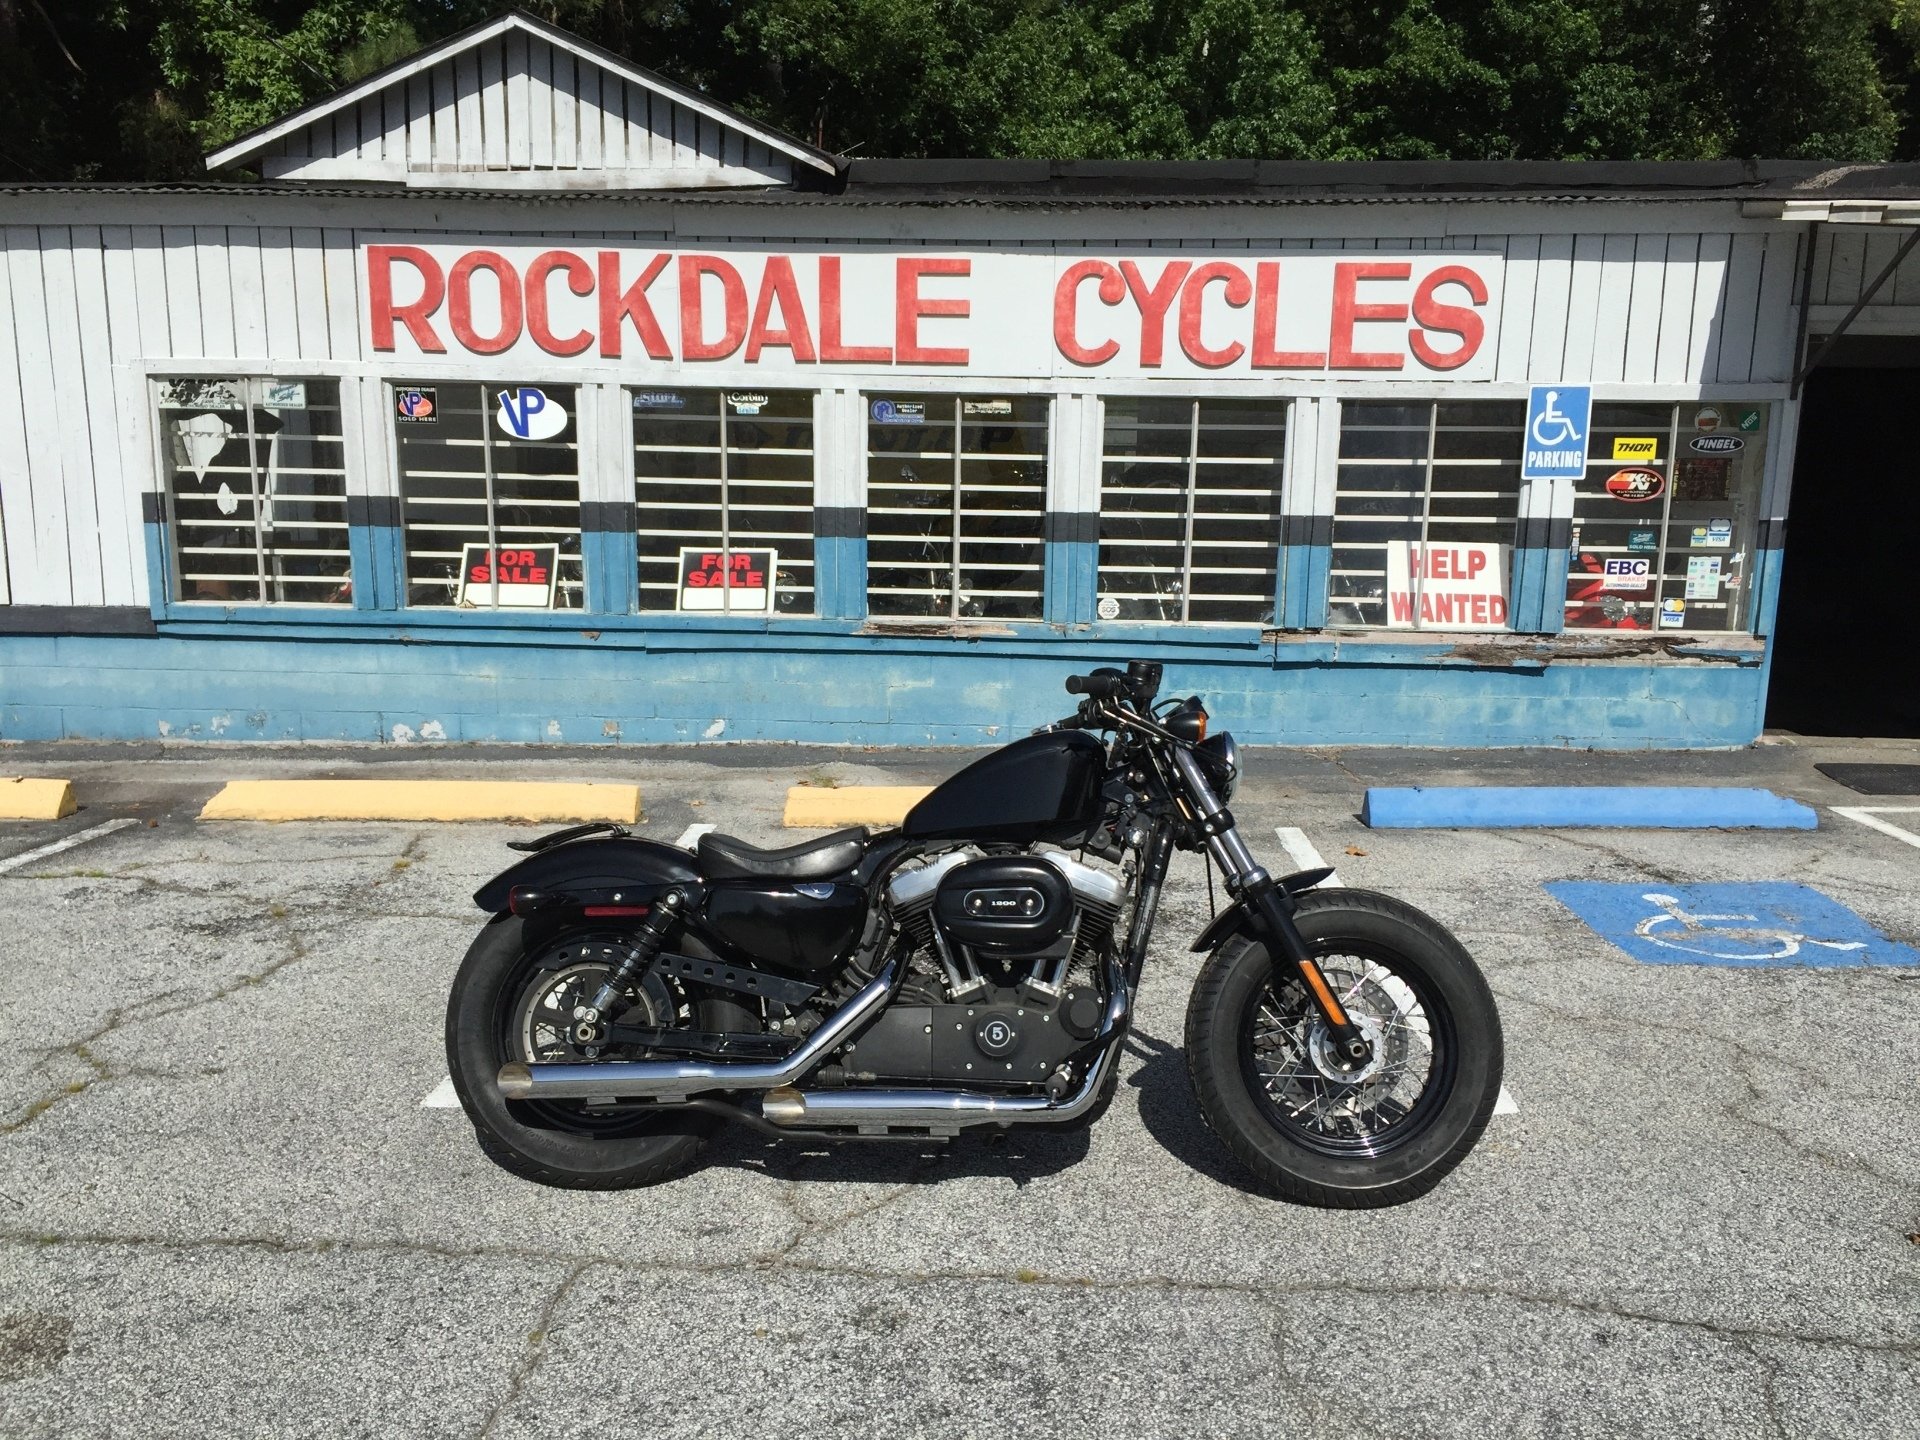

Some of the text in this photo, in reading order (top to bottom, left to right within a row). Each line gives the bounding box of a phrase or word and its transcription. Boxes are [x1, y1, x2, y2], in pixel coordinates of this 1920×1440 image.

[367, 245, 1489, 371] ROCKDALE CYCLES
[731, 392, 764, 402] Corbin
[498, 387, 546, 438] VP
[1617, 443, 1653, 452] THOR
[1697, 439, 1736, 449] PINGEL
[1528, 451, 1582, 468] PARKING
[701, 554, 751, 570] FOR
[1410, 549, 1487, 580] HELP
[1606, 561, 1647, 575] EBC
[470, 566, 547, 583] SALE
[688, 571, 763, 587] SALE
[1391, 591, 1507, 624] WANTED
[992, 1027, 1004, 1040] 5
